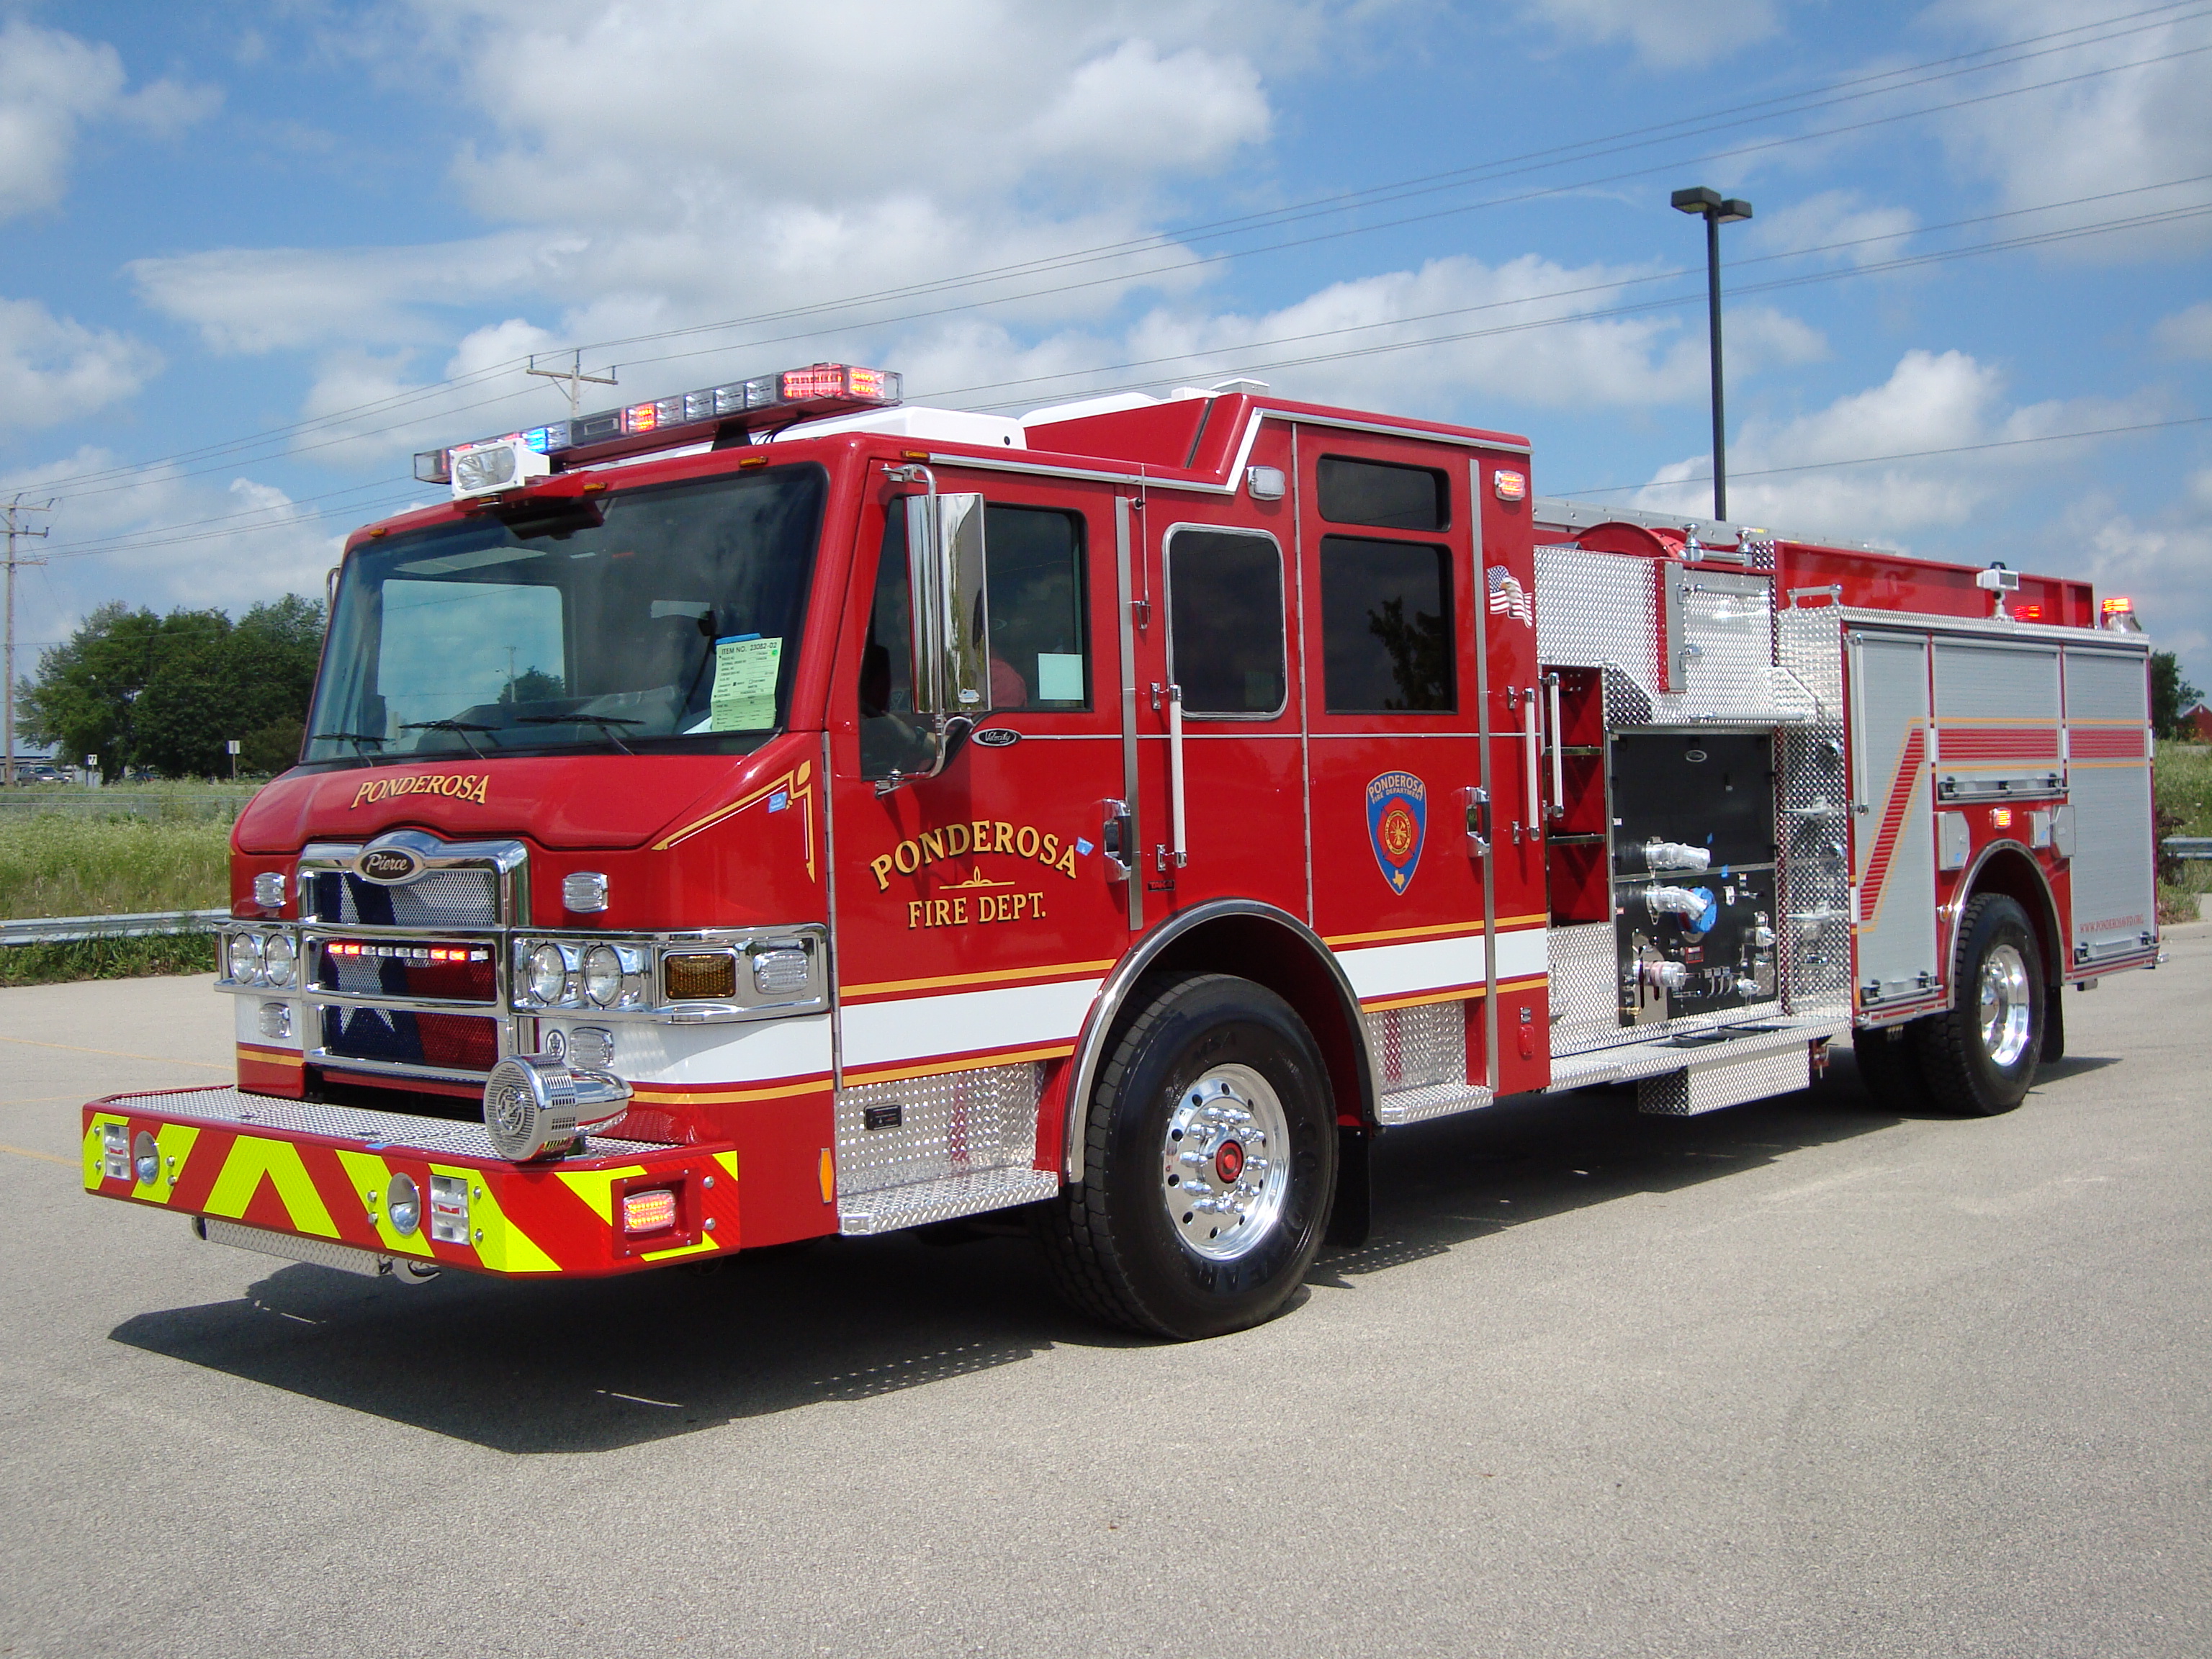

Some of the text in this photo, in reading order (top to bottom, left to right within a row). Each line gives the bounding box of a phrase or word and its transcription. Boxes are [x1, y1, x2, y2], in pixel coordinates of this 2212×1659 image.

[351, 774, 490, 809] PONDEROSA
[1368, 775, 1424, 799] PONDEROSA
[1372, 788, 1423, 804] FIRE DEPARTMENT
[366, 853, 408, 873] Pierce
[871, 819, 1076, 890] PONDEROSA
[908, 891, 1046, 927] FIRE DEPT.
